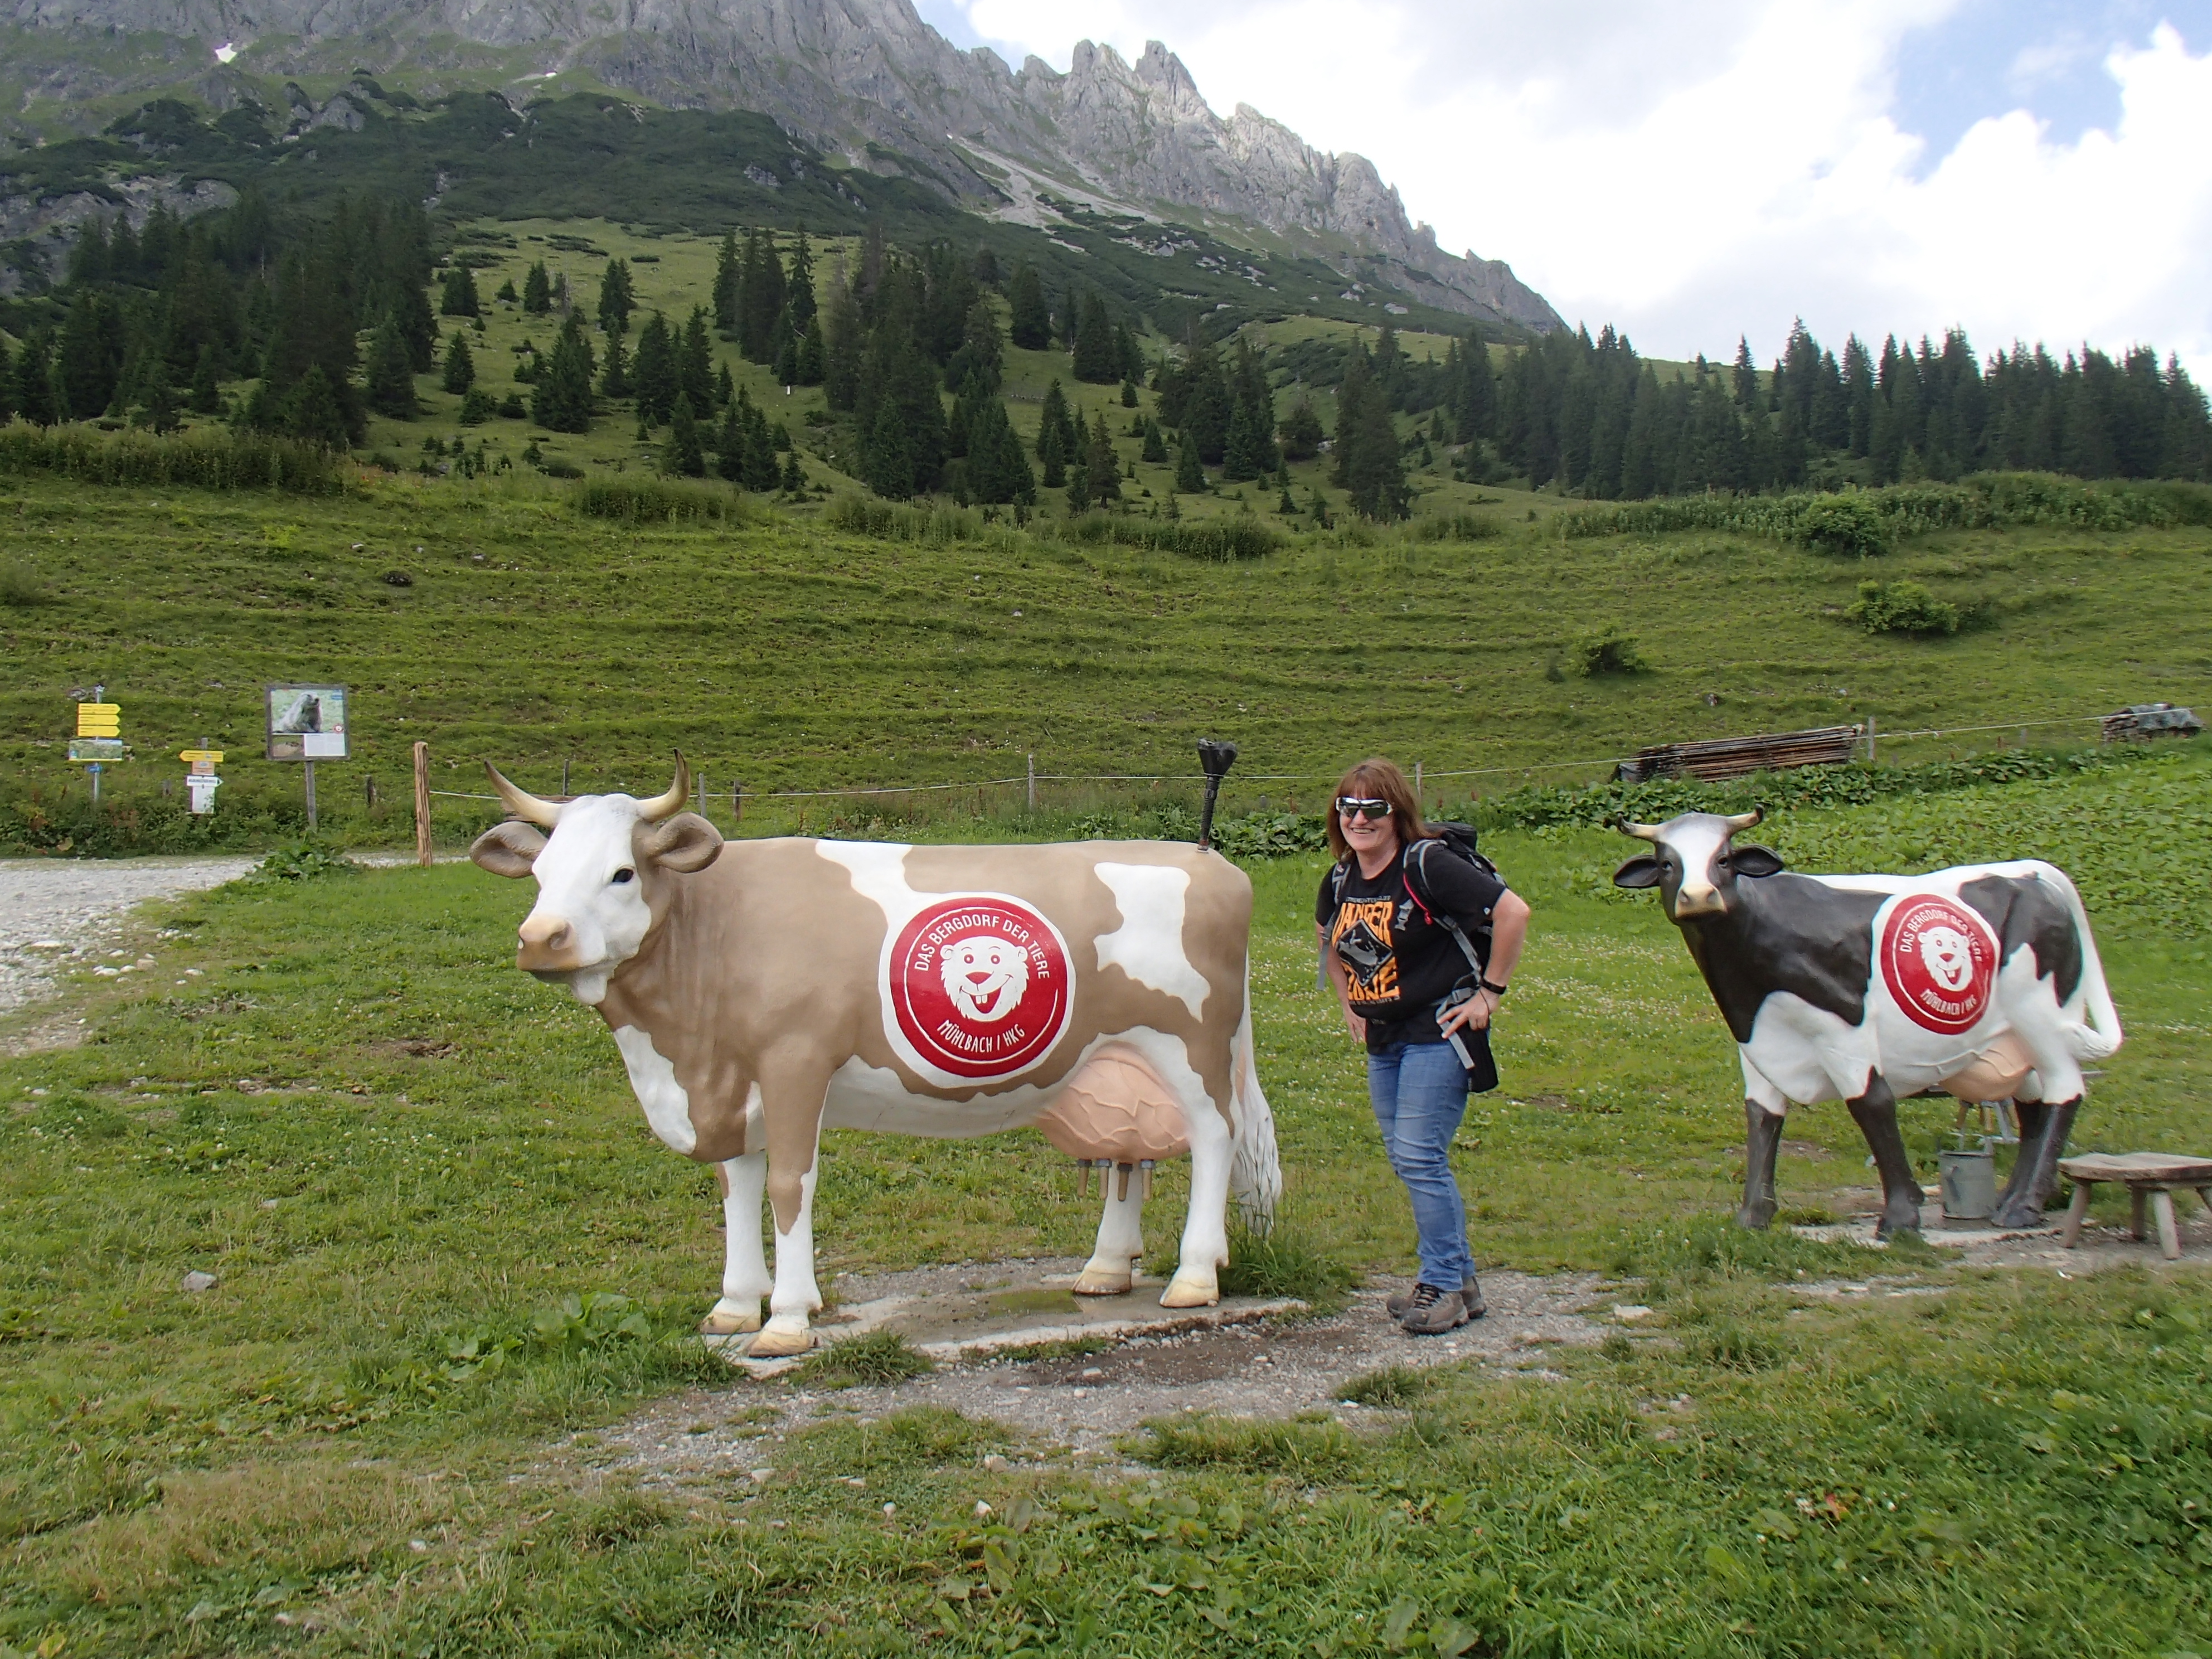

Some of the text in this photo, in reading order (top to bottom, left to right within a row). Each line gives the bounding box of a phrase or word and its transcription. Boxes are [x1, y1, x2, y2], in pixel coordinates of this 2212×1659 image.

[914, 914, 1050, 979] DAS BERGDORF DER TIERE
[1332, 901, 1393, 948] DANGER
[1900, 931, 1915, 953] DAS
[1341, 957, 1400, 1001] ZONE
[937, 1020, 992, 1052] MÜHLBACH
[1003, 1023, 1025, 1047] HKG
